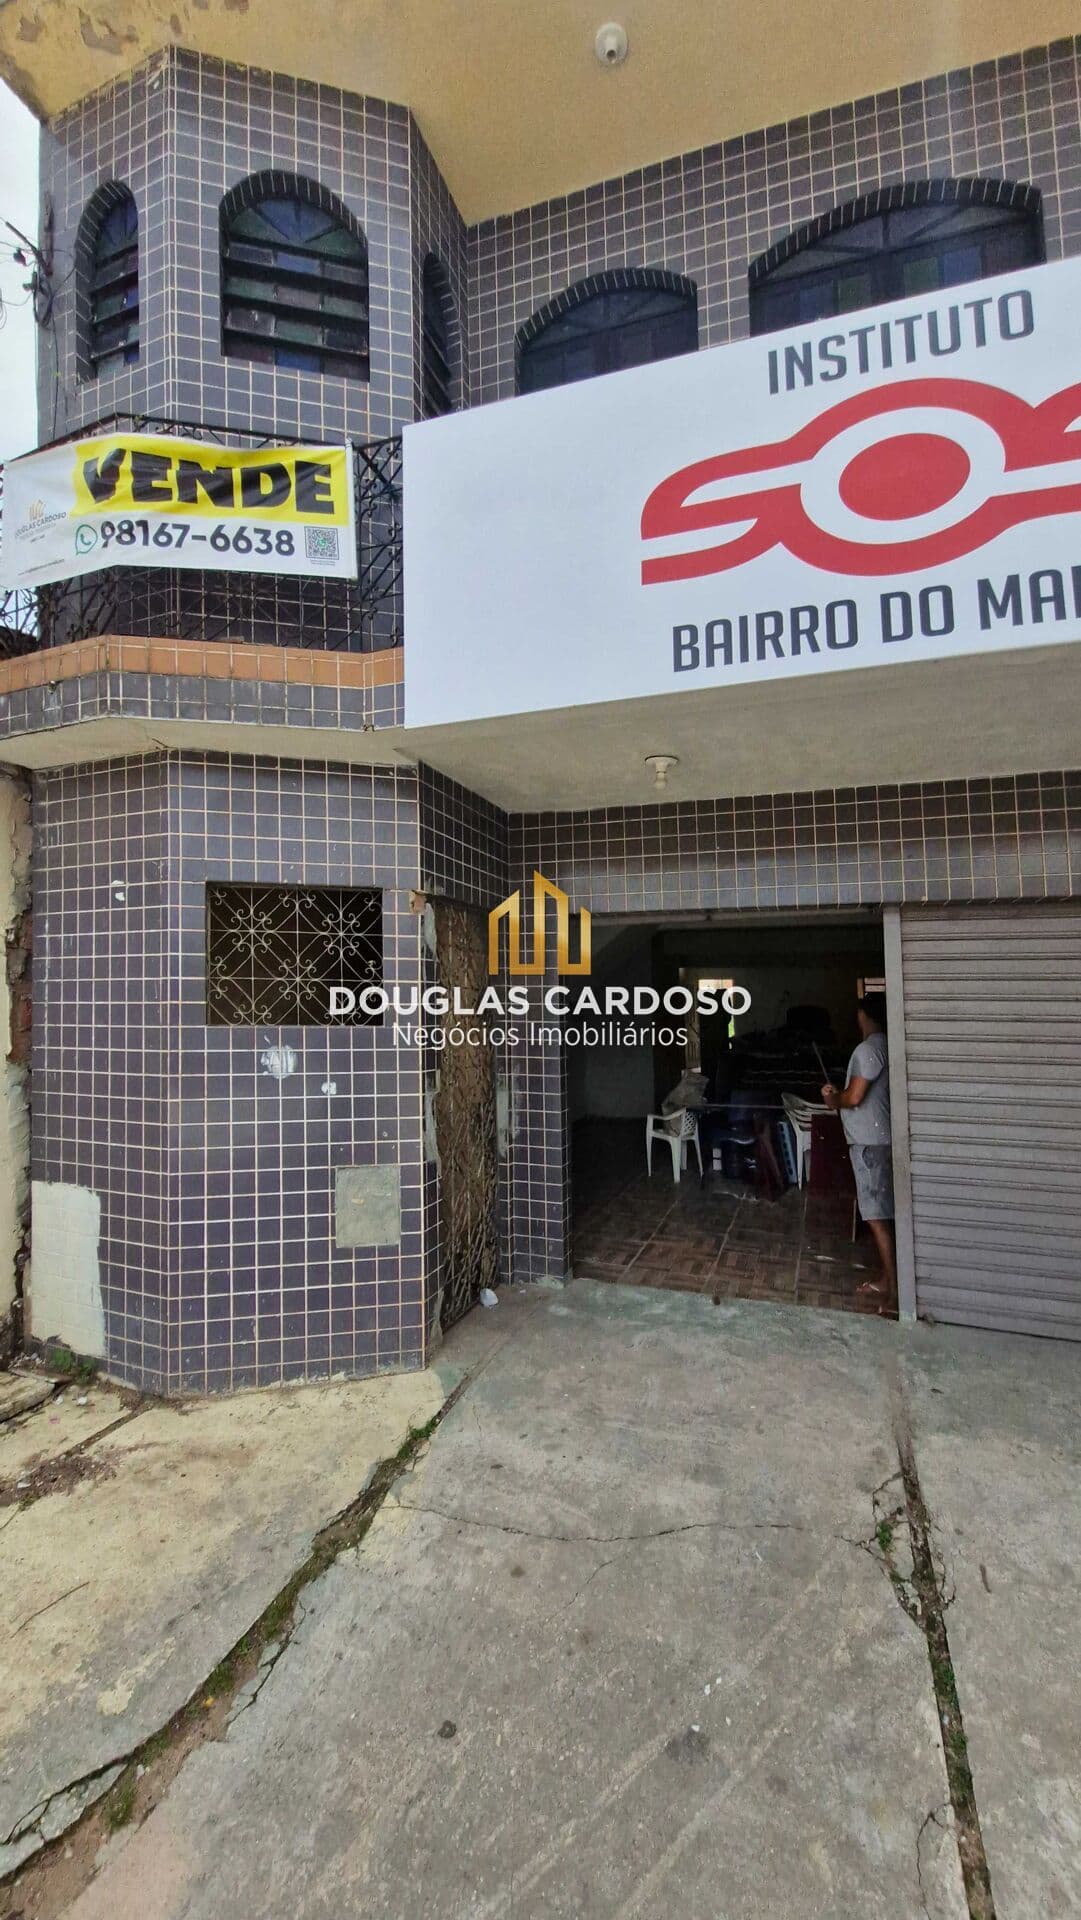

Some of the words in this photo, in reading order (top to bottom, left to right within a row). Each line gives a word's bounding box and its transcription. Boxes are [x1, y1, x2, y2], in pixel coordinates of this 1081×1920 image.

[768, 289, 1034, 394] INSTITUTO
[83, 448, 335, 514] VENDE
[100, 519, 295, 556] 98167-6638
[672, 599, 858, 672] BAIRRO
[879, 584, 955, 643] DO
[977, 565, 1081, 630] MA
